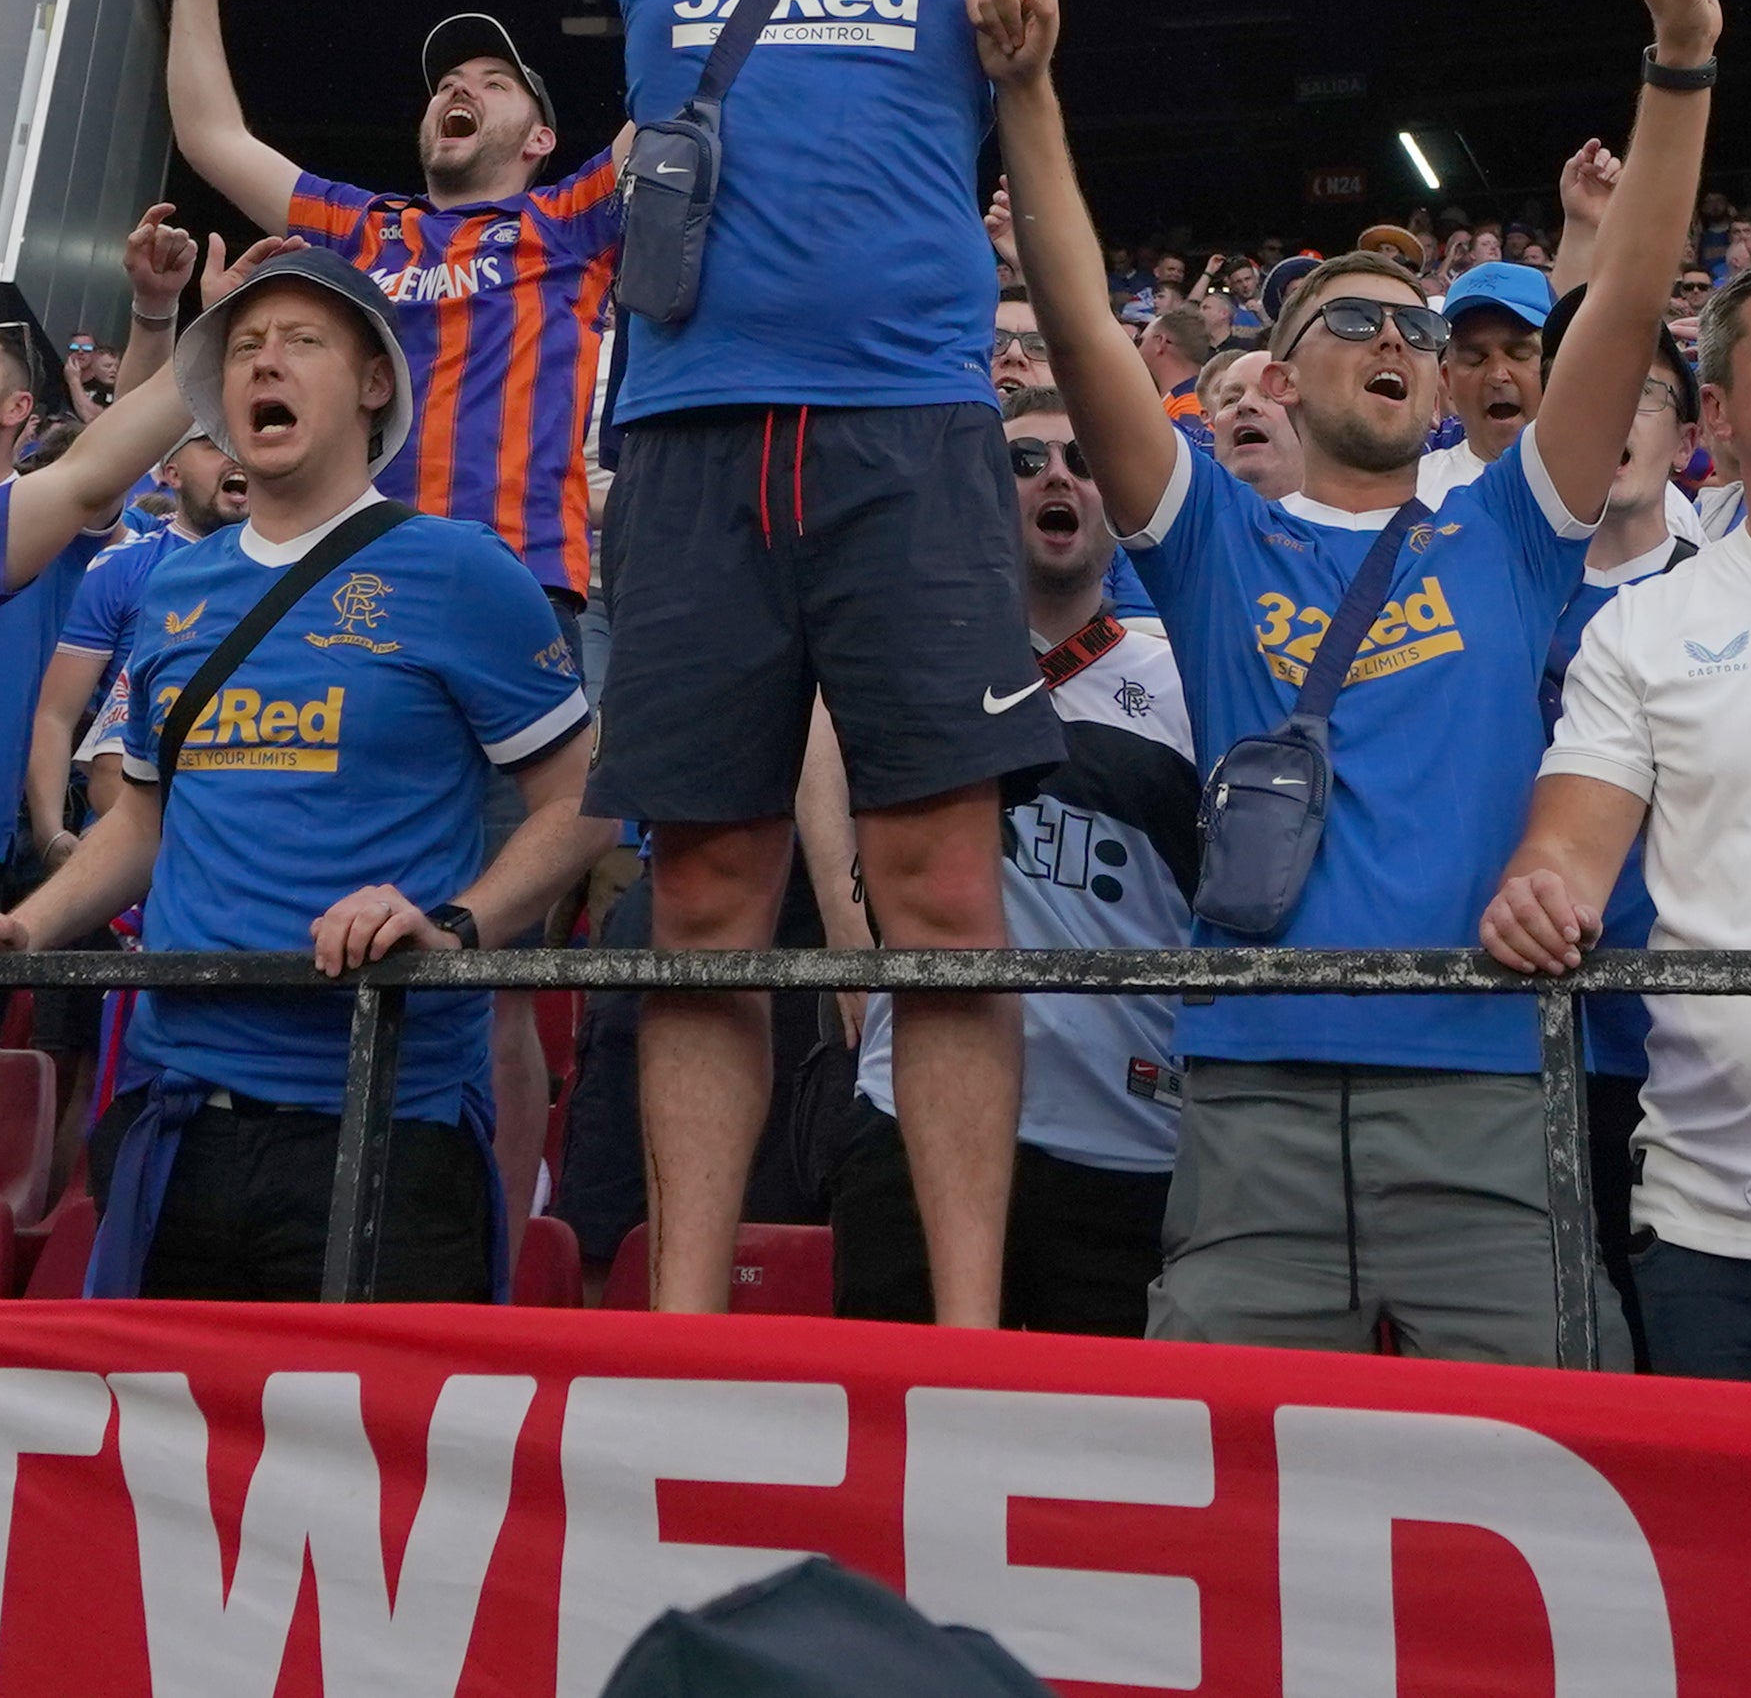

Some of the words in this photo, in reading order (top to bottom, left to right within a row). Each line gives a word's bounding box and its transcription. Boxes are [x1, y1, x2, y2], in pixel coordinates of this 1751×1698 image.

[781, 26, 874, 43] CONTROL
[1250, 575, 1453, 652] 32ed
[1361, 647, 1421, 676] LIMITS
[1688, 658, 1747, 677] CASTORE
[205, 750, 245, 766] YOUR
[249, 751, 296, 766] LIMITS
